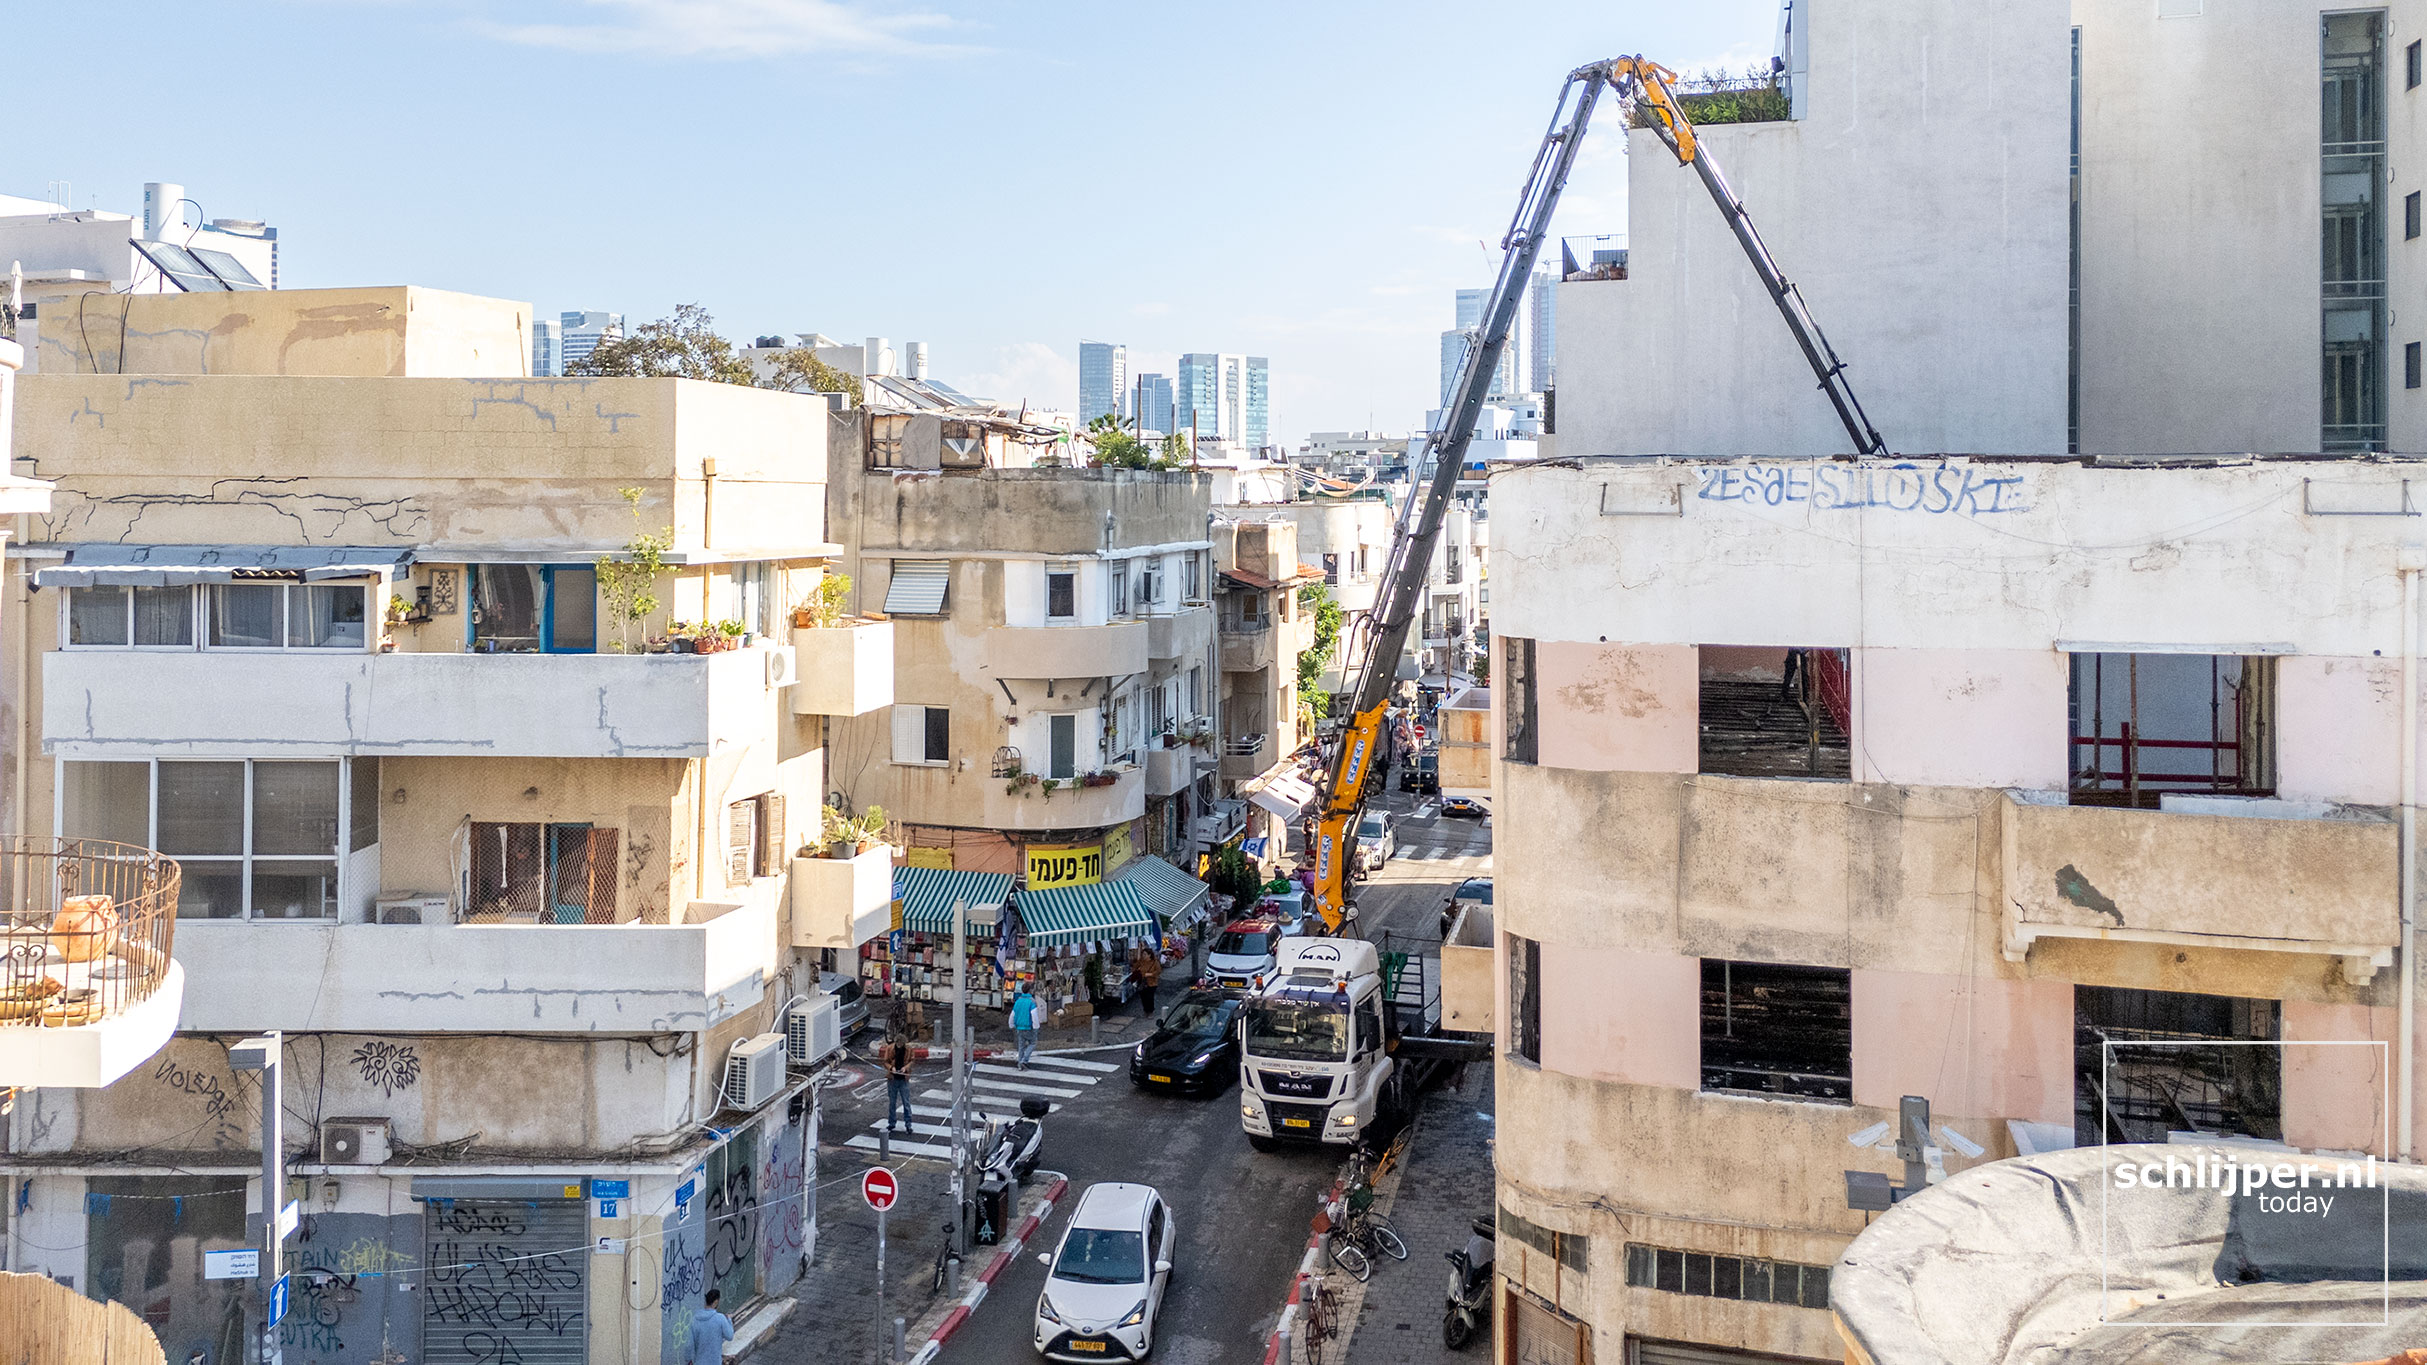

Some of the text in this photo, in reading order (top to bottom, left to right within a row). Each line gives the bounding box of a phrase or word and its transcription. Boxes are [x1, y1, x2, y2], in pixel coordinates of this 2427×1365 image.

[1030, 853, 1100, 882] חד-פעמי
[1278, 1081, 1312, 1090] MAN
[602, 1203, 616, 1214] 17
